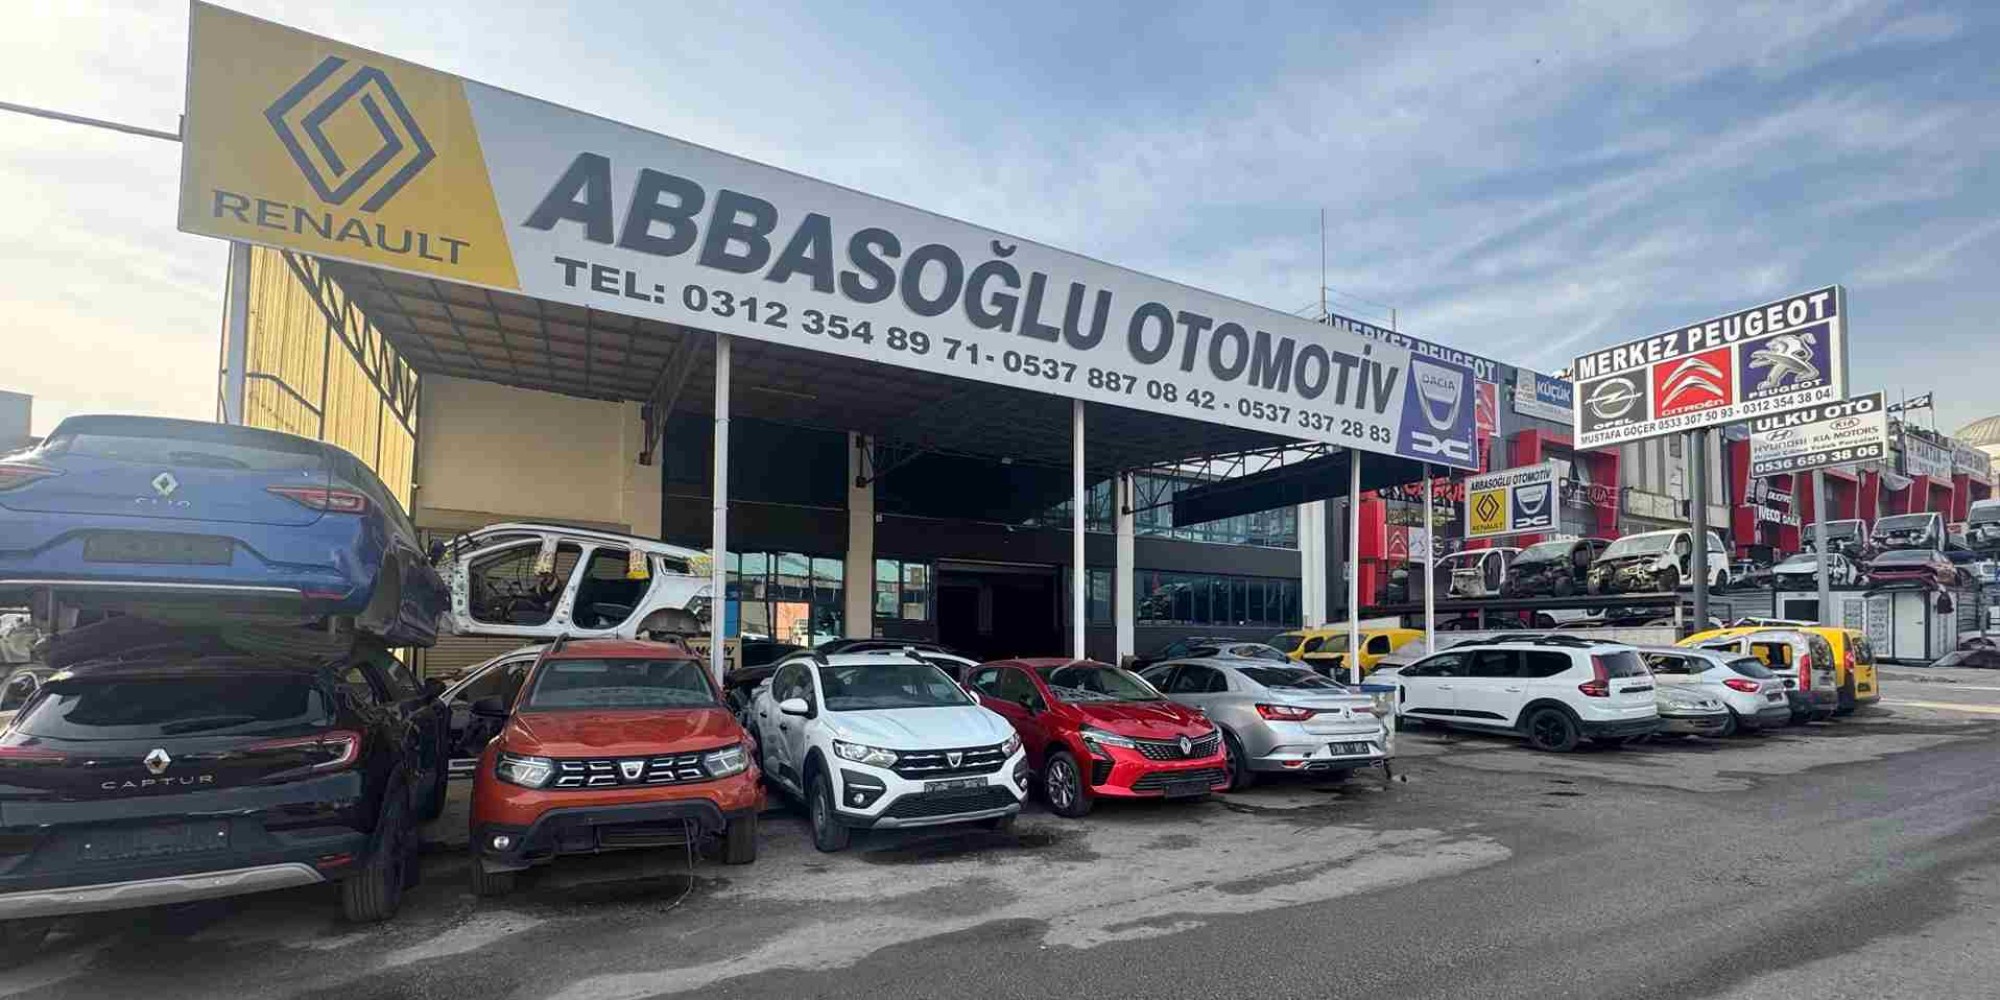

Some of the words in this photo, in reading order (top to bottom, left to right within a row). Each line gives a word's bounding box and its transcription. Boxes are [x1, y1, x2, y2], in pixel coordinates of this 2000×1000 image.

[211, 190, 470, 264] RENAULT
[521, 152, 1112, 352] ABBASOĞLU
[1128, 301, 1400, 415] OTOMOTİV
[1579, 333, 1680, 380] MERKEZ
[1687, 292, 1829, 352] PEUGEOT
[554, 256, 666, 304] TEL:
[682, 284, 788, 330] 0312
[801, 309, 875, 344] 354
[886, 326, 932, 355] 89
[1002, 350, 1078, 383] 0537
[1087, 367, 1138, 395] 887
[1146, 379, 1178, 402] 08
[1186, 388, 1216, 411] 42
[1237, 398, 1291, 425] 0537
[1298, 410, 1335, 435] 337
[1340, 418, 1364, 439] 28
[1368, 423, 1392, 445] 83
[1422, 374, 1455, 391] DACIA
[1748, 378, 1824, 399] PEUGEOT
[1581, 429, 1621, 446] MUSTAFA
[1659, 418, 1682, 431] 0533
[1684, 413, 1704, 426] 307
[1705, 410, 1718, 421] 50
[1720, 407, 1734, 416] 93
[1743, 400, 1770, 415] 0312
[1773, 396, 1795, 409] 354
[1797, 391, 1813, 403] 38
[1815, 387, 1831, 400] 04
[1593, 418, 1635, 431] OPEL
[1756, 409, 1818, 431] ULKU
[1824, 399, 1874, 418] OTO
[1835, 418, 1856, 428] KIA
[1754, 437, 1808, 453] HYUNDAI
[1813, 434, 1831, 443] KIA
[1833, 426, 1880, 440] MOTORS
[1754, 459, 1793, 473] 0536
[1797, 453, 1827, 466] 659
[1831, 450, 1853, 461] 38
[1856, 445, 1880, 457] 06
[101, 773, 218, 791] CAPTUR
